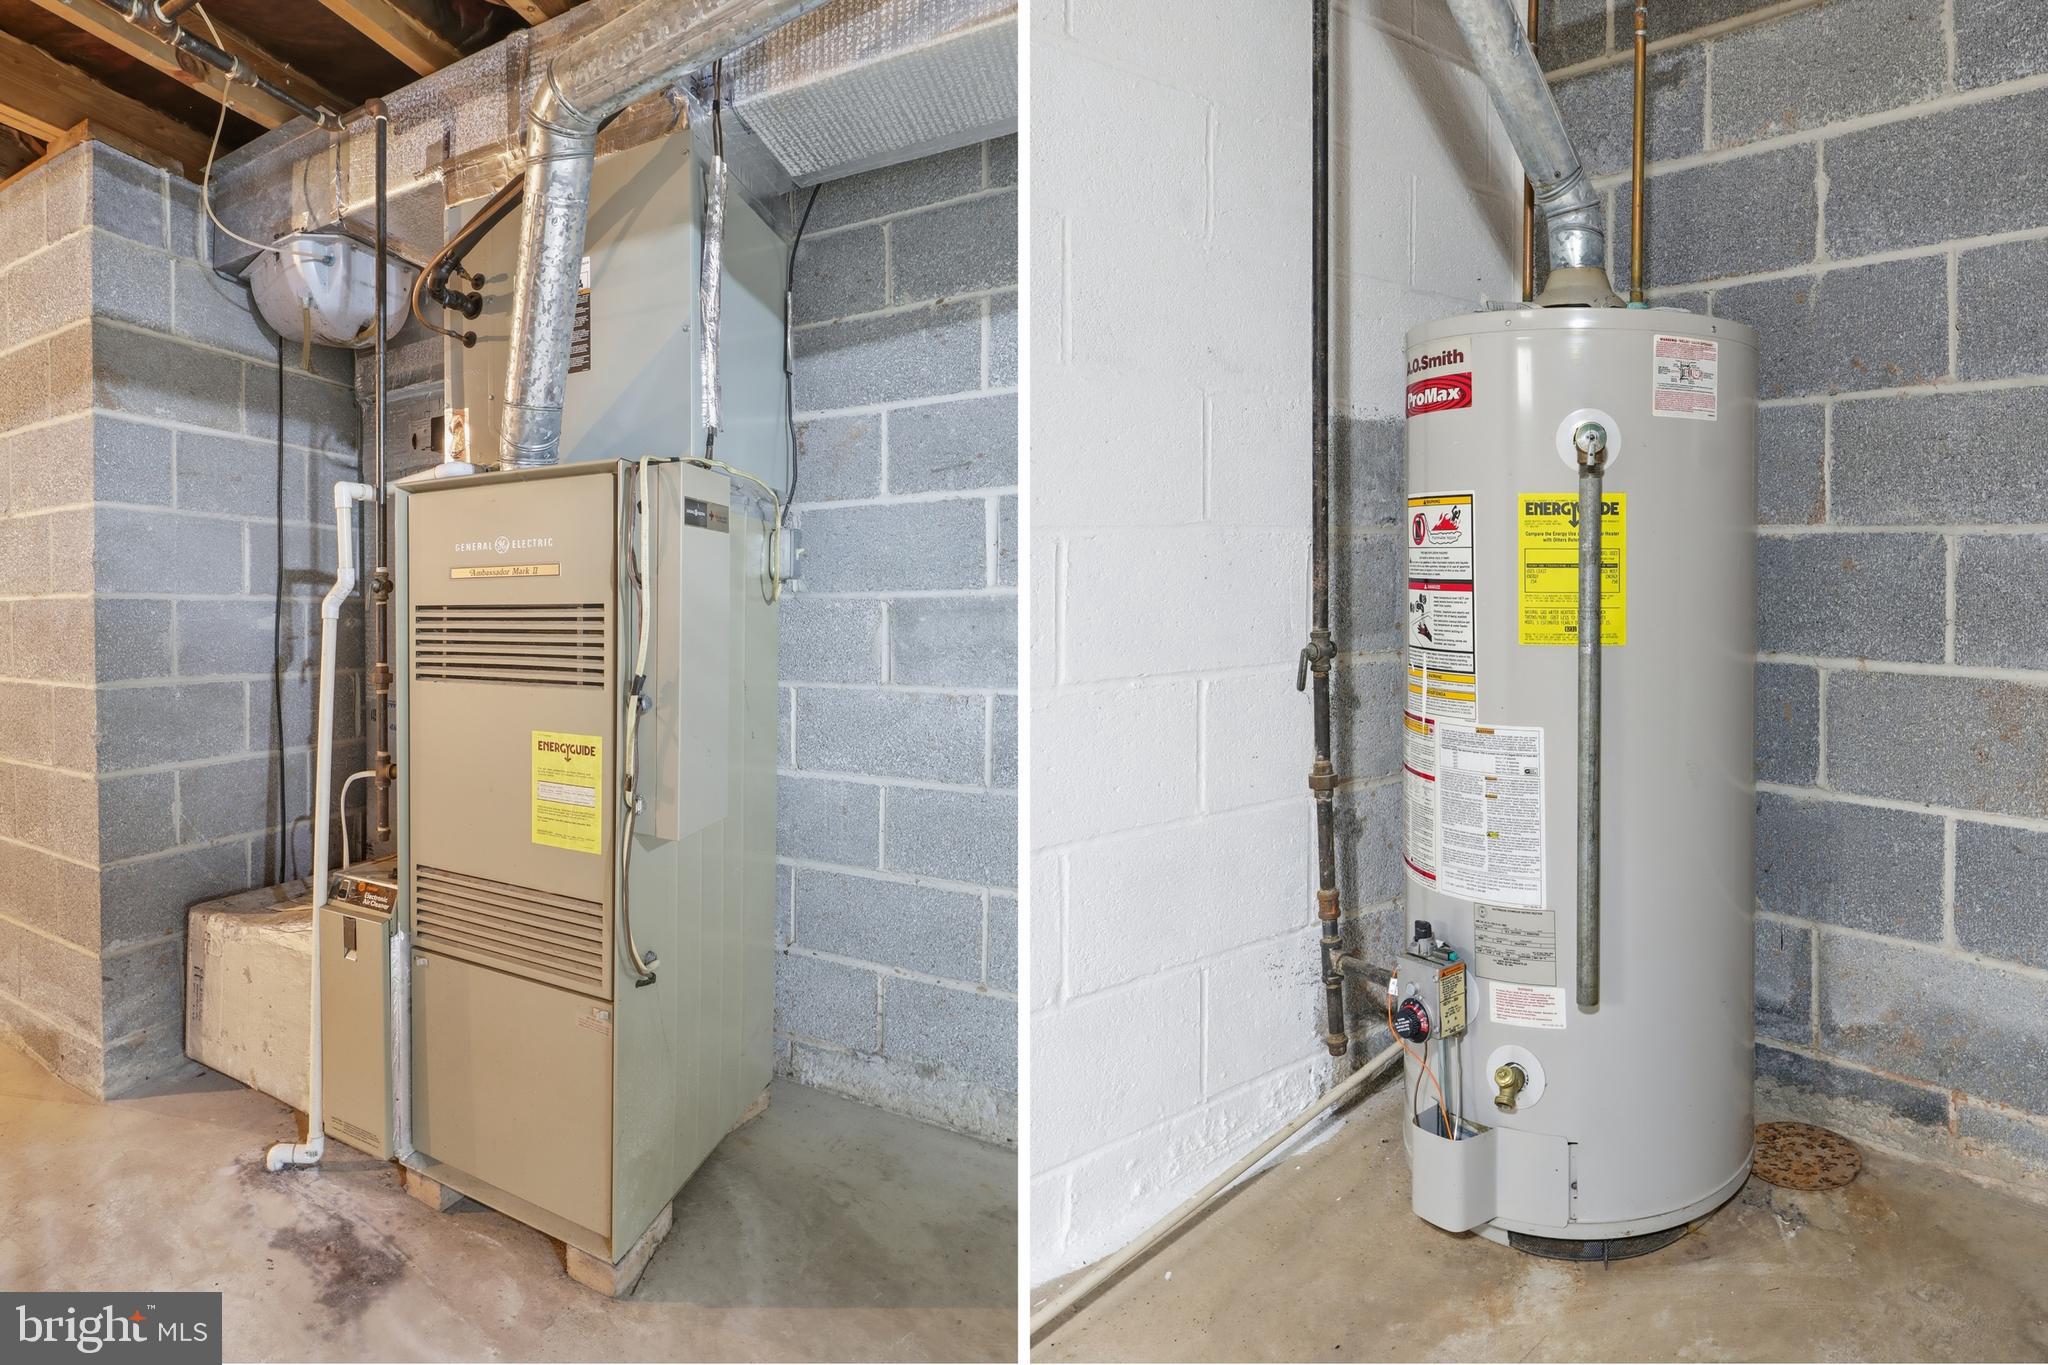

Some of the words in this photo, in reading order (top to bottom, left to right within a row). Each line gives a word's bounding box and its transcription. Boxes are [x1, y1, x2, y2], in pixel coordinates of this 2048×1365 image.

[1408, 387, 1460, 409] ProMax
[1525, 501, 1620, 521] ENERGYDE
[455, 542, 492, 552] GENERAL
[512, 537, 553, 549] ELECTRIC
[469, 567, 510, 576] Ambassador
[512, 567, 530, 576] Mark
[532, 567, 538, 575] II
[537, 740, 596, 760] ENERGYGUIDE
[364, 892, 388, 903] Electronic
[370, 900, 389, 910] Cleaner
